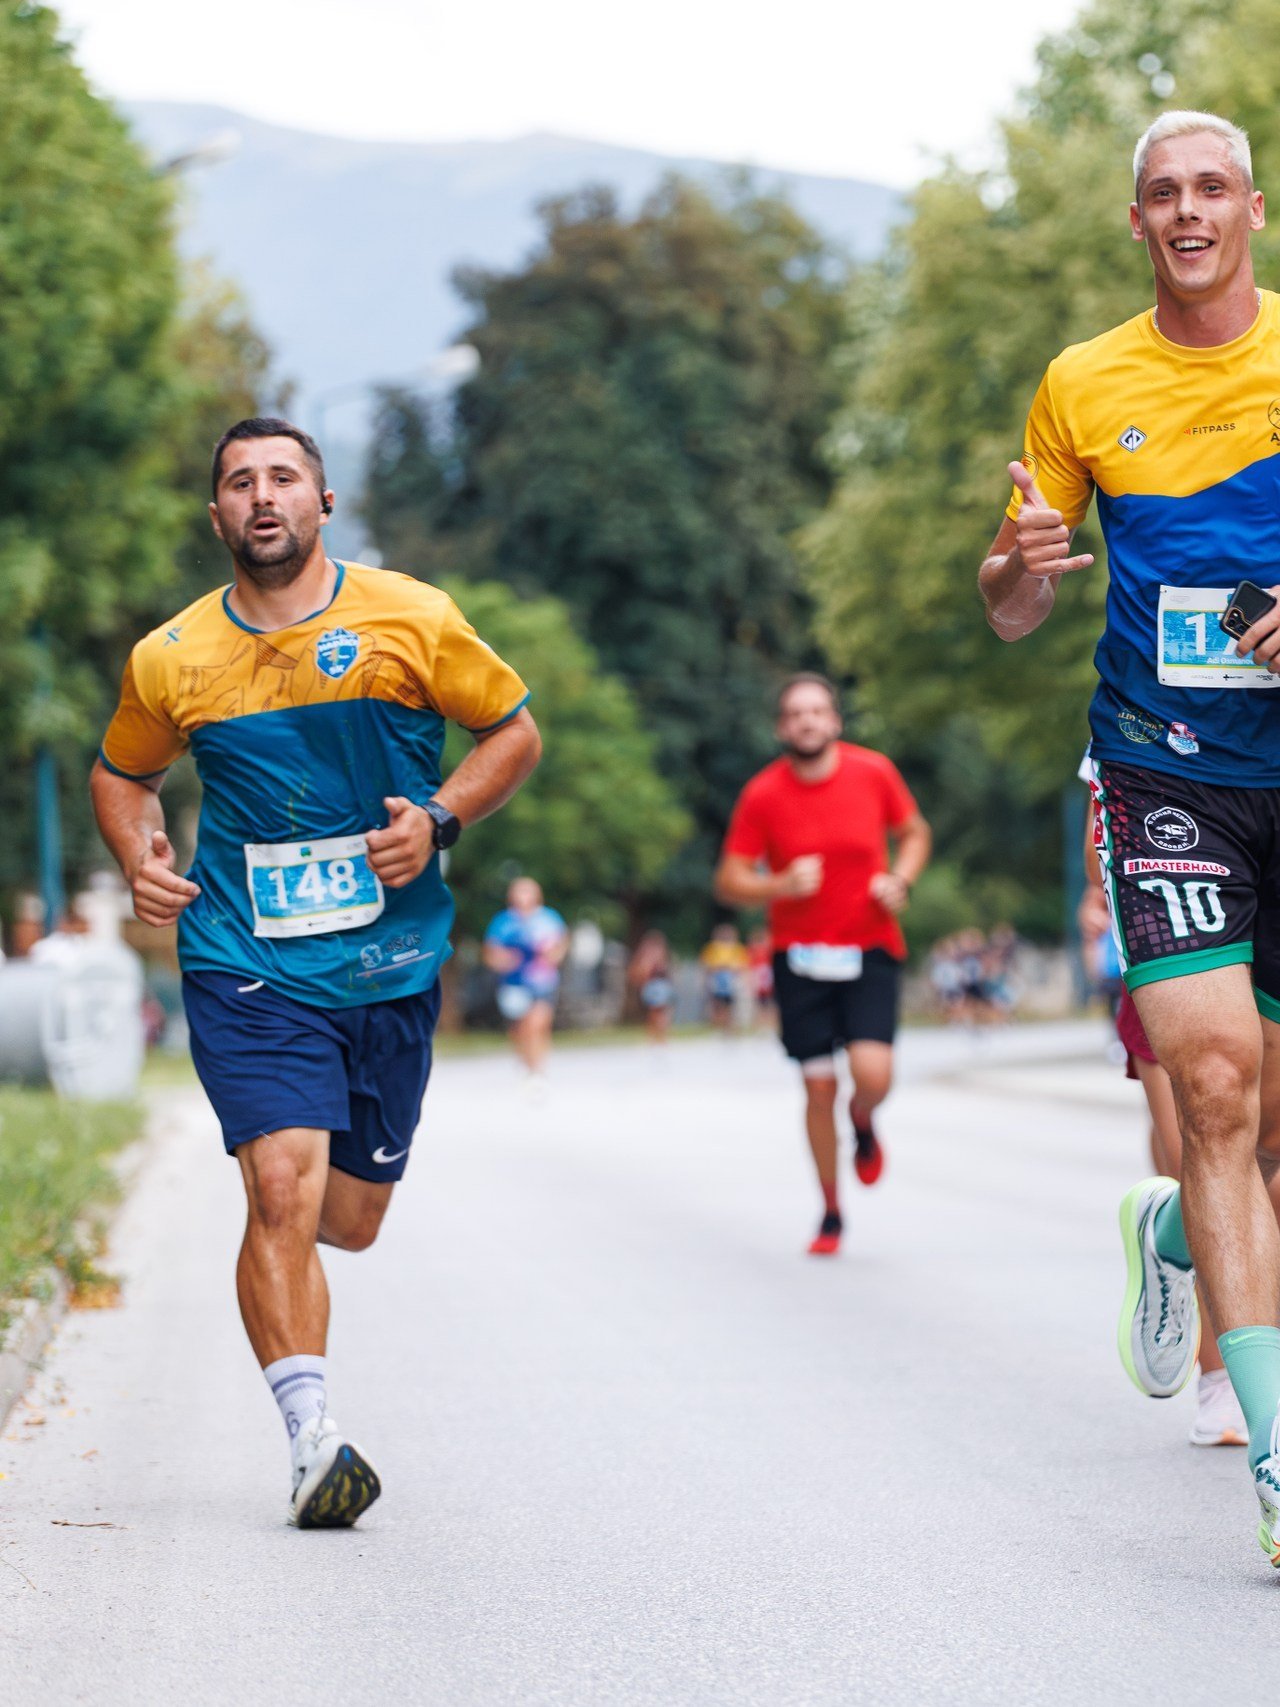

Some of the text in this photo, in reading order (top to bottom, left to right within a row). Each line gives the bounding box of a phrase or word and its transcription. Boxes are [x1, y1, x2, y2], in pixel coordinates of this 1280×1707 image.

[1192, 422, 1236, 435] FITPASS
[1141, 859, 1226, 874] MASTERHAUS
[268, 859, 358, 908] 148
[1137, 878, 1227, 938] 70
